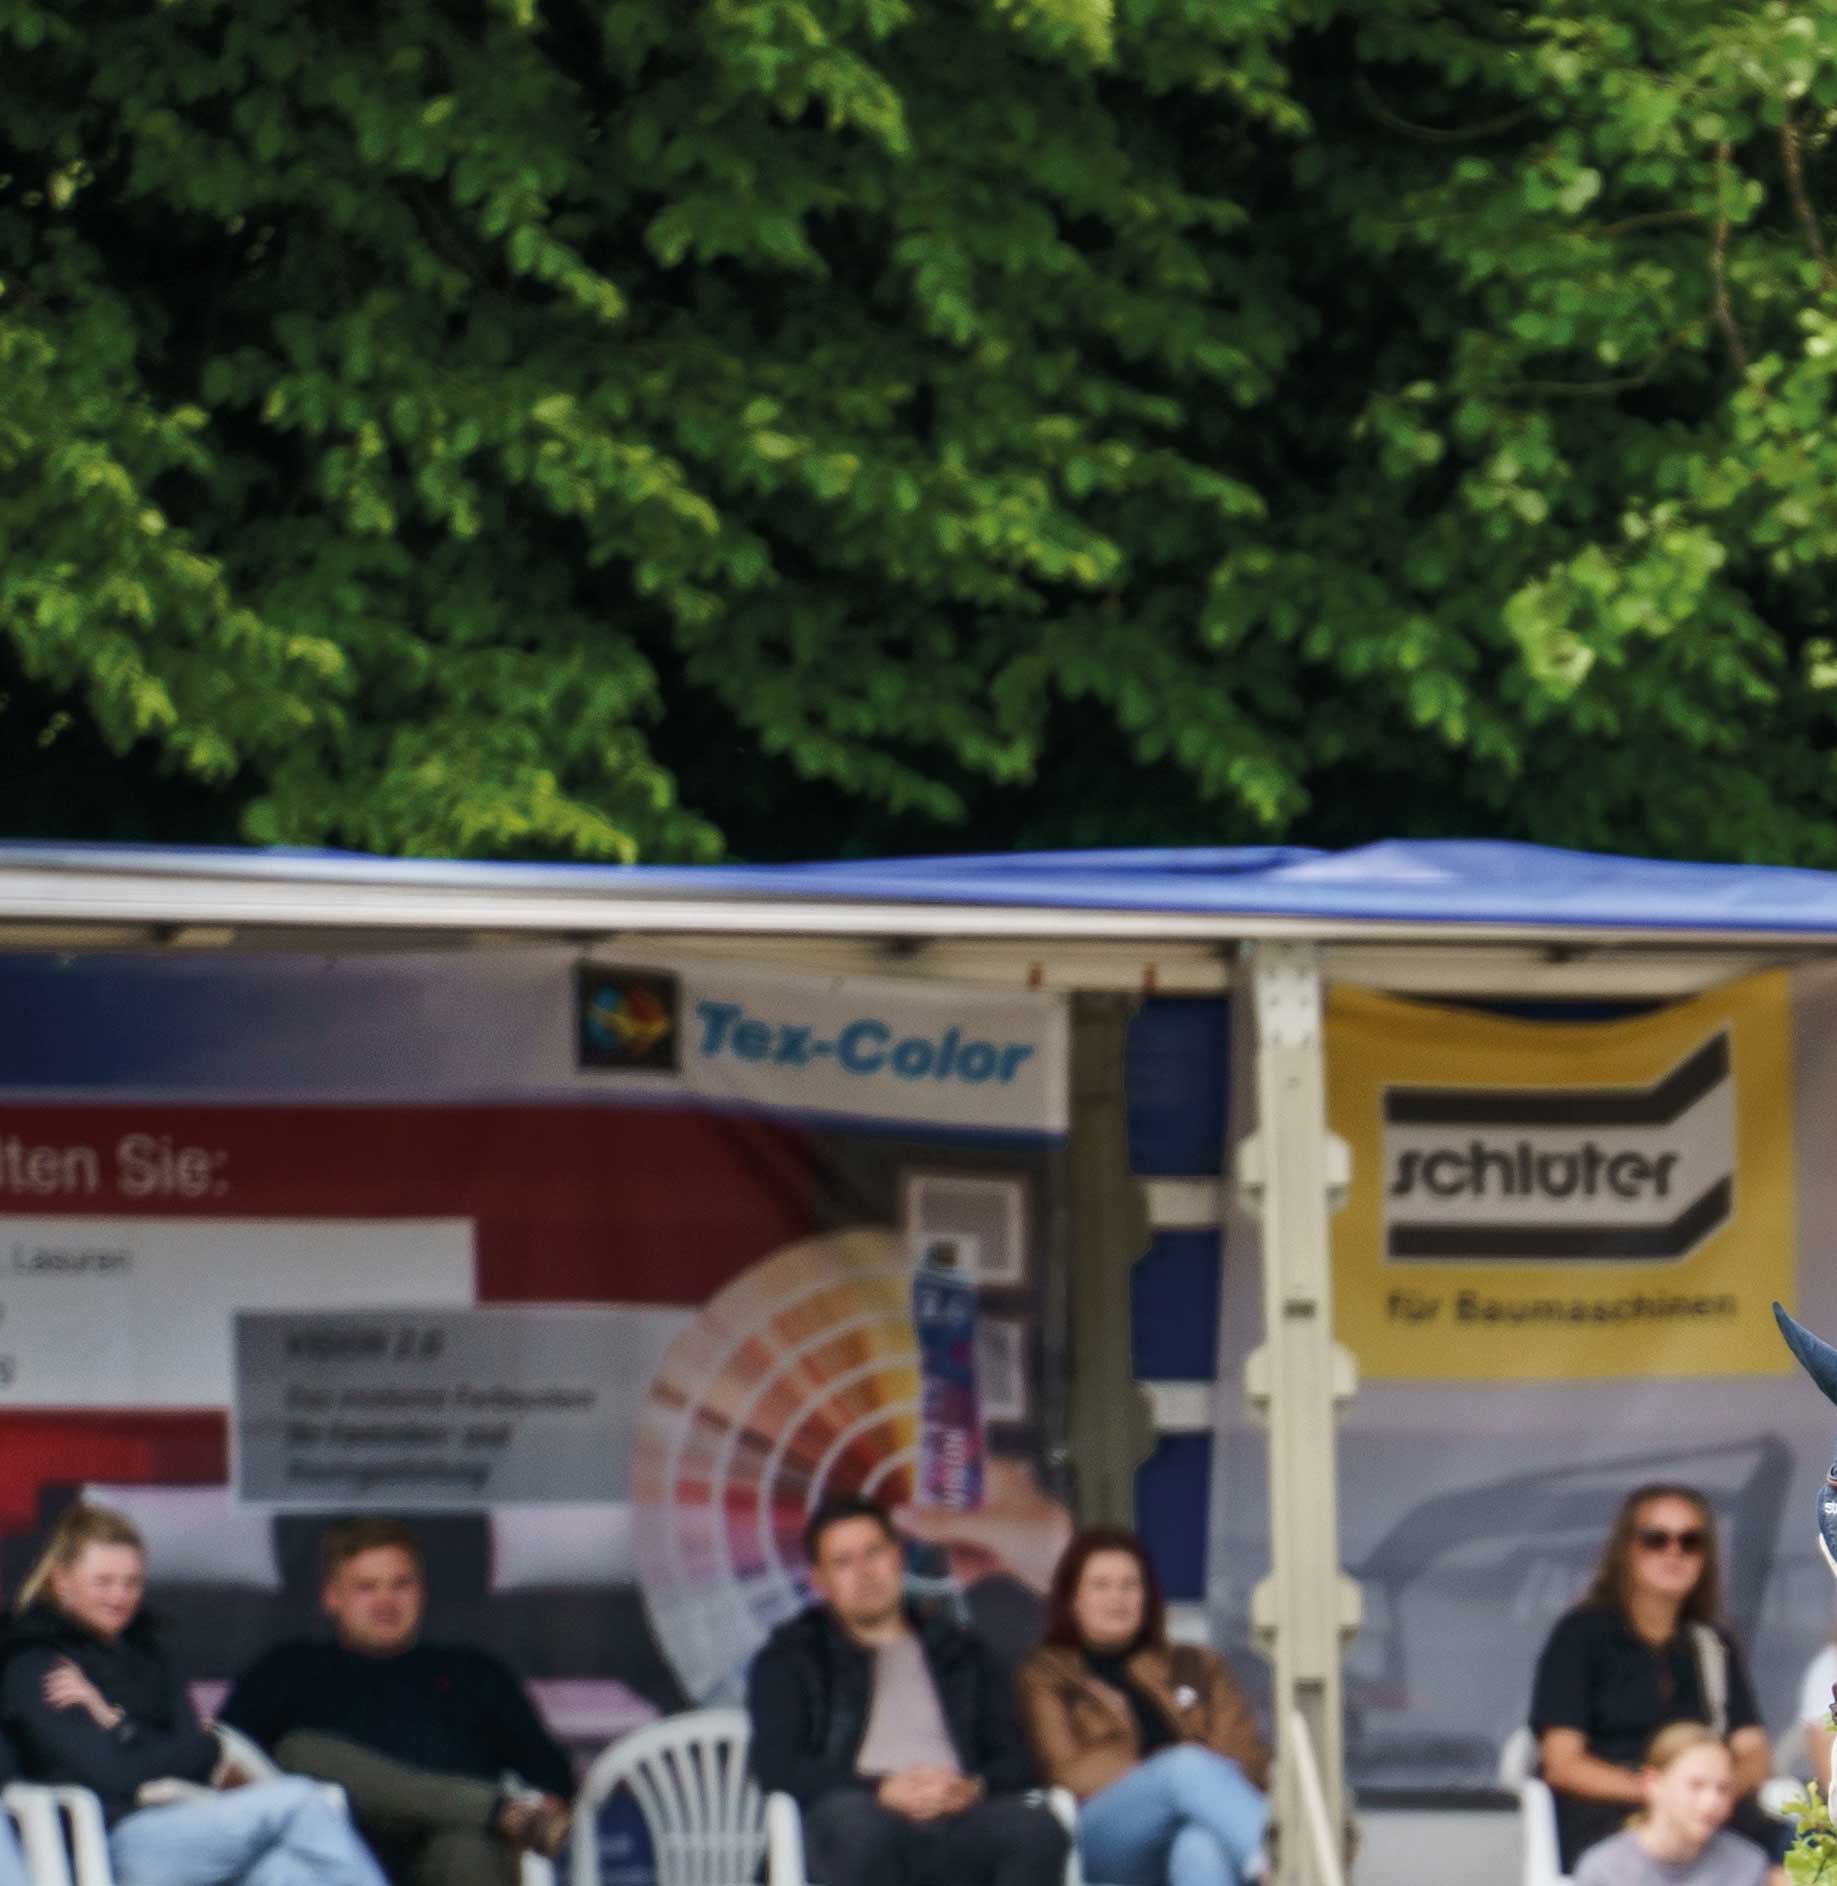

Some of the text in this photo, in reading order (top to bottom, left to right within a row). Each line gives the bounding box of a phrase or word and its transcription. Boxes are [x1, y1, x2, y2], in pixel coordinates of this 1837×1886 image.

[697, 999, 1036, 1086] Tex-Color
[0, 1132, 231, 1198] ten Sie:
